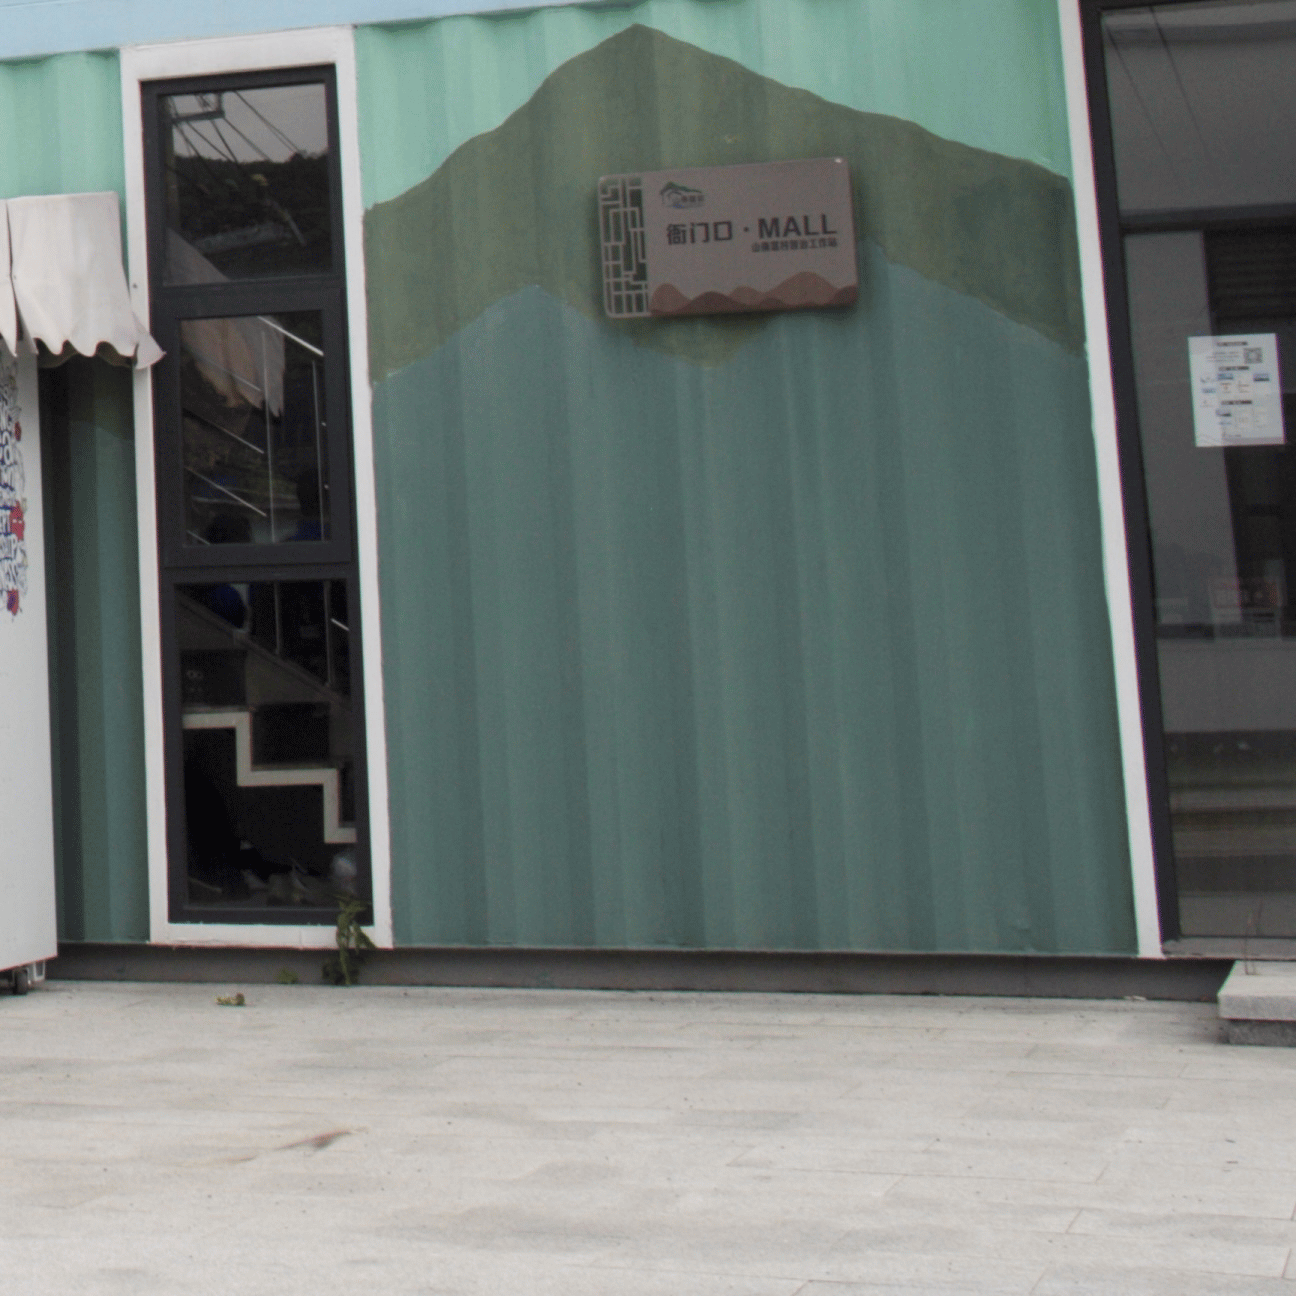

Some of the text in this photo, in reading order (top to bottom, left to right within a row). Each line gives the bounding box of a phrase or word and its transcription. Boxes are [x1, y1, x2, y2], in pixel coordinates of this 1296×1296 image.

[666, 213, 837, 246] 衙门口 MALL
